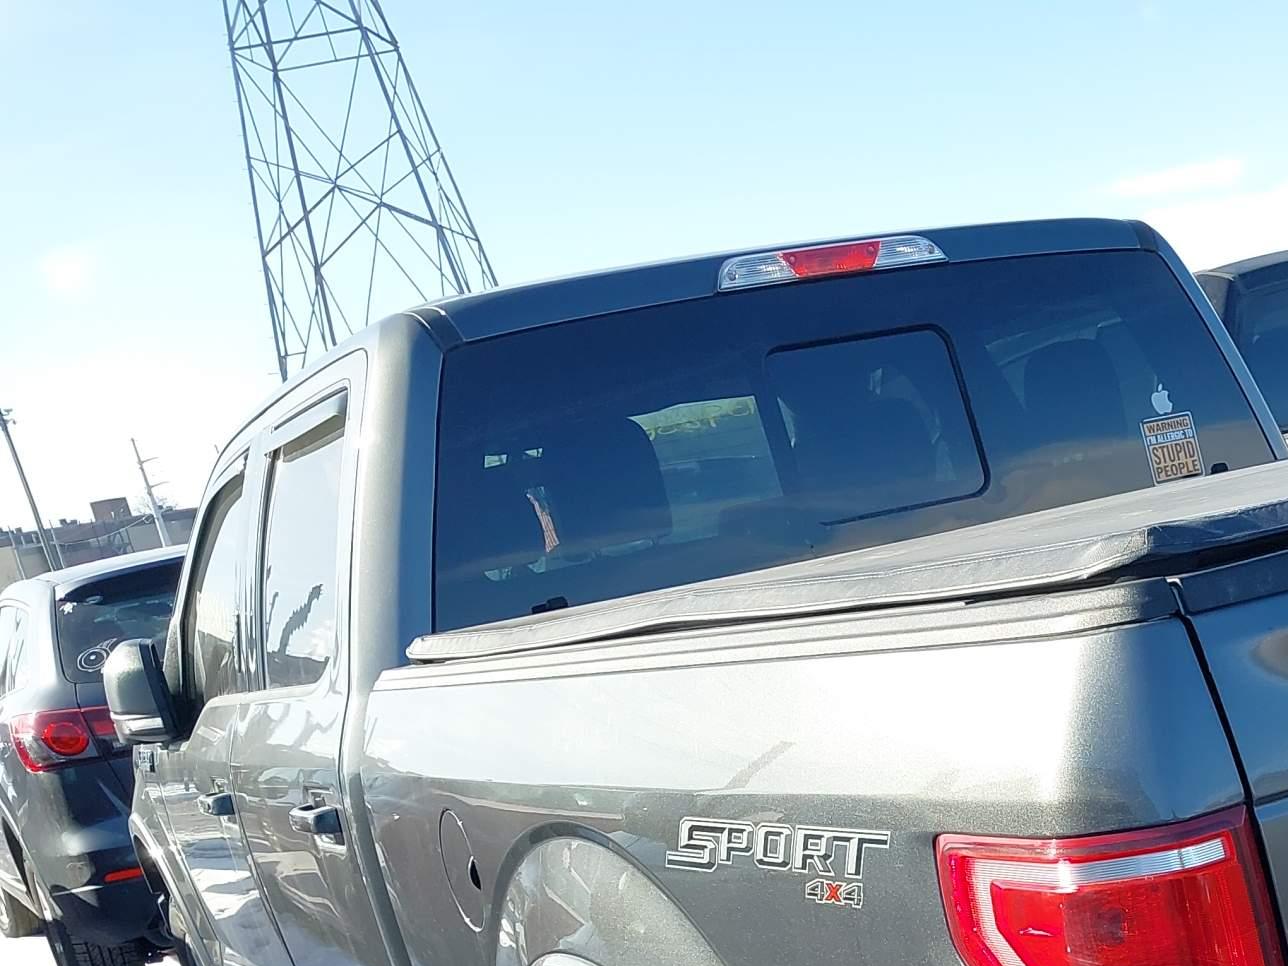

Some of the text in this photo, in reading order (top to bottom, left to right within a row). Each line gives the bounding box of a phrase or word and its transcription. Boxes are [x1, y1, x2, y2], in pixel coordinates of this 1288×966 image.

[1146, 417, 1189, 434] WARNING
[1157, 430, 1185, 444] ALLERGIC
[1185, 429, 1193, 438] TO
[1151, 440, 1196, 465] STUPID
[1156, 459, 1200, 480] PEOPLE
[665, 816, 891, 879] SPORT
